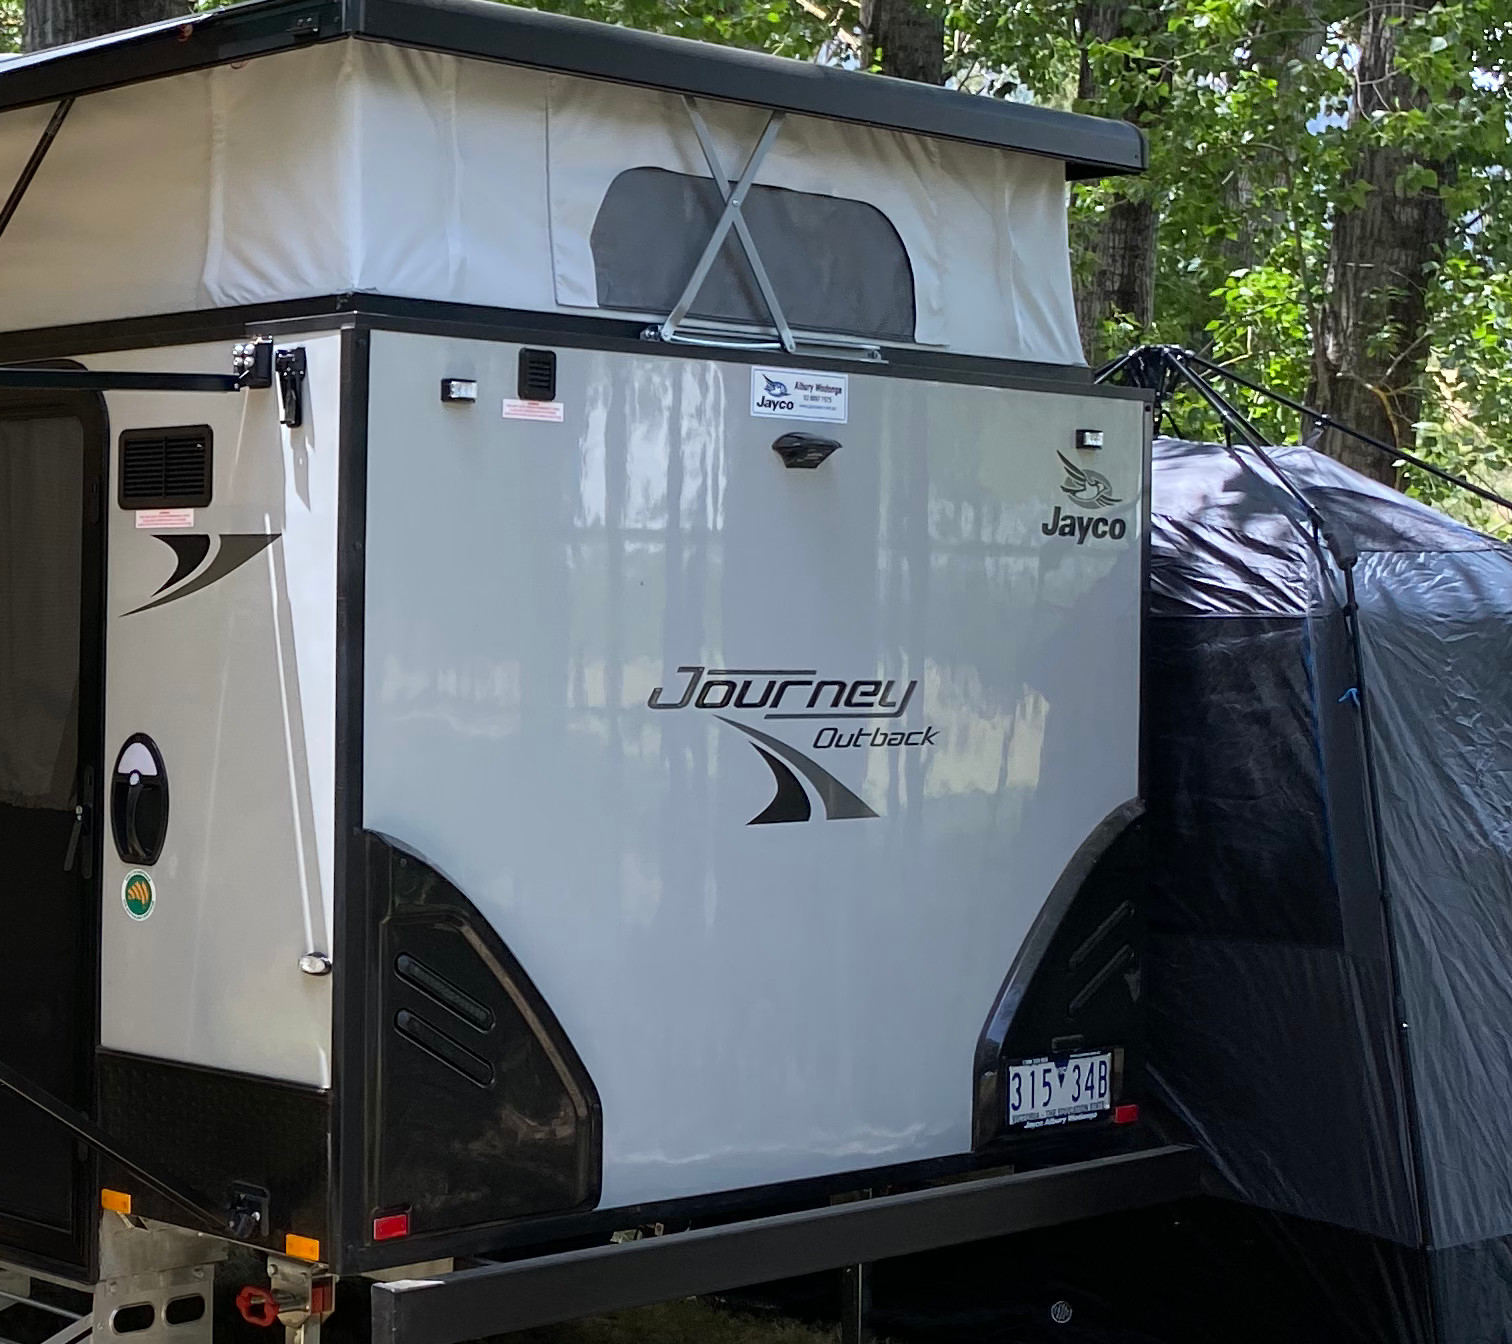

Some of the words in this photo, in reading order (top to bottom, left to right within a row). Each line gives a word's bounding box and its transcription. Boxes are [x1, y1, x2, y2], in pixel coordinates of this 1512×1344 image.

[756, 396, 794, 411] Jayco
[1041, 505, 1126, 545] Jayco
[647, 666, 918, 720] Journey
[812, 726, 941, 749] Outback
[1011, 1068, 1053, 1111] 315
[1071, 1060, 1108, 1103] 34B
